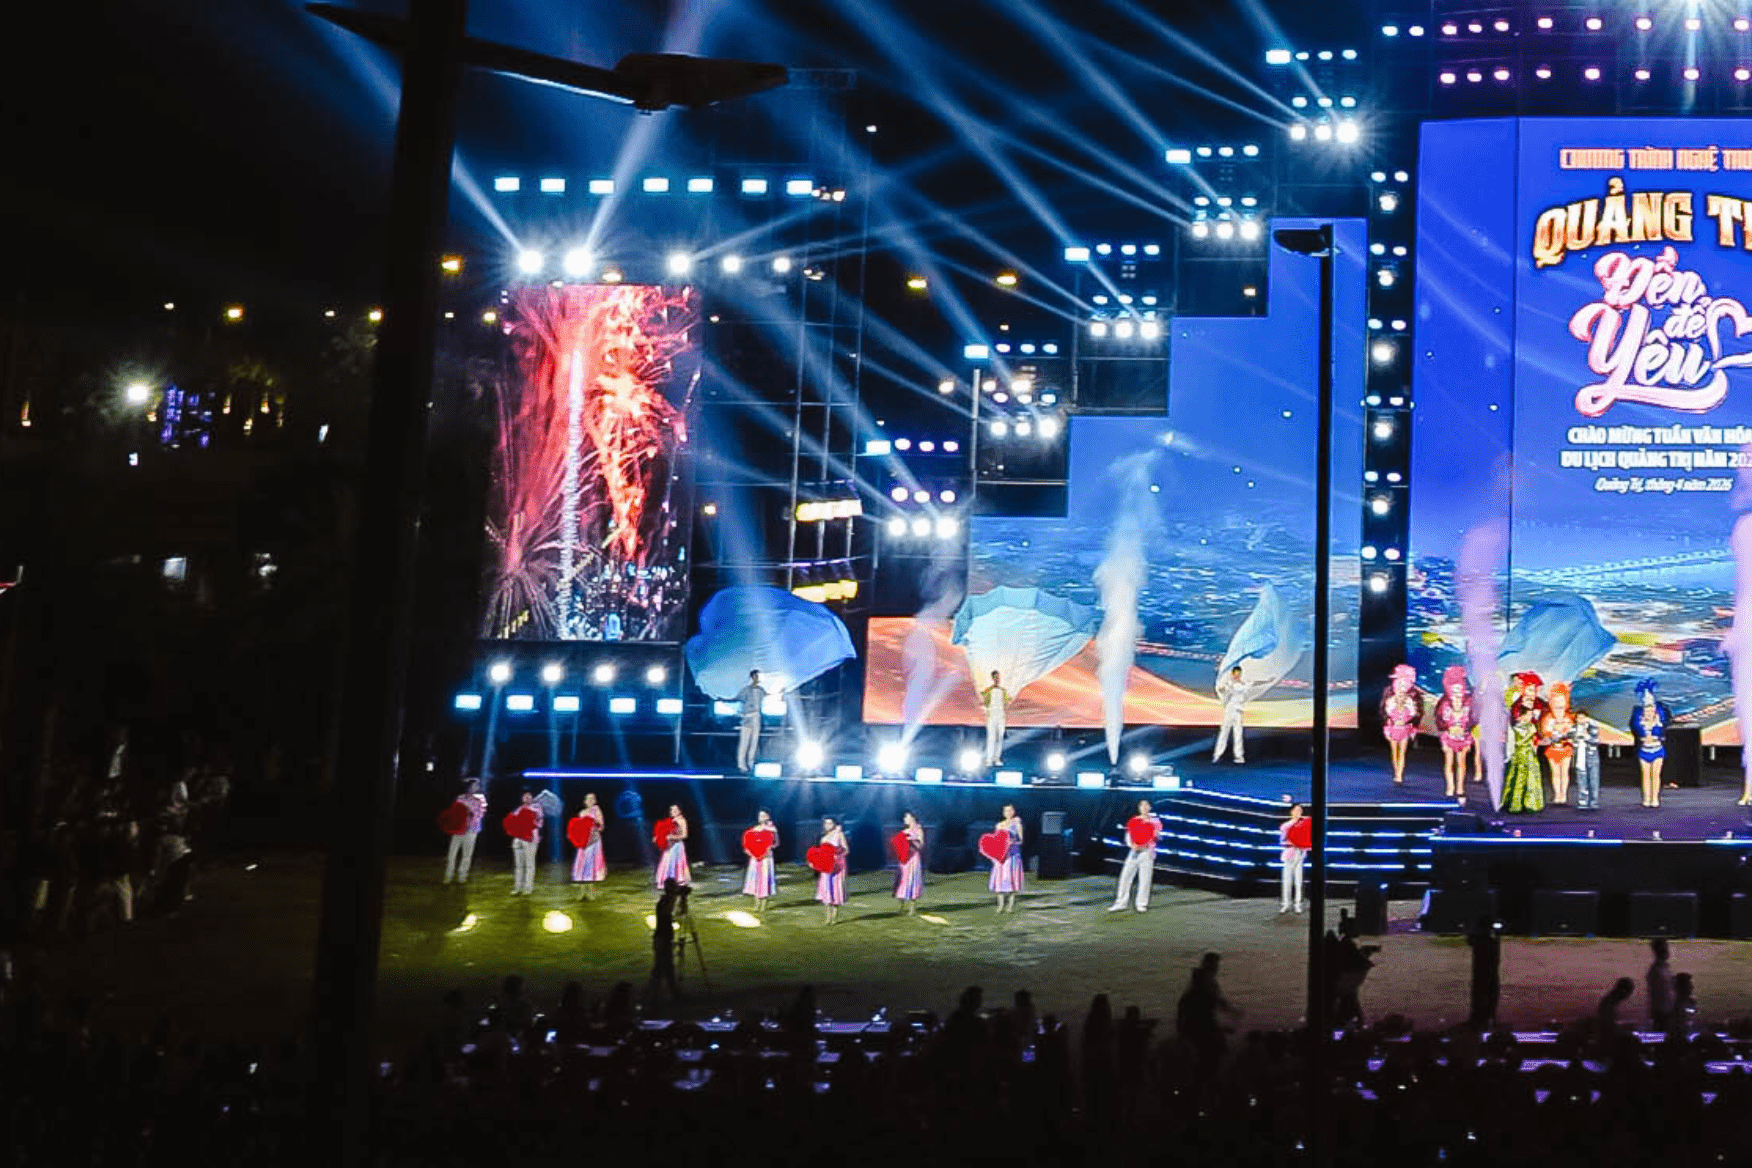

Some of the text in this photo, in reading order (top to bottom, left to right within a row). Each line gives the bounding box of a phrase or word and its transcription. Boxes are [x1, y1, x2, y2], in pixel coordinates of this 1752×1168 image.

[1532, 176, 1693, 269] QUẢNG
[1568, 301, 1728, 419] Yêu
[1560, 450, 1583, 468] DU
[1584, 450, 1617, 471] LỊCH
[1617, 447, 1668, 469] QUẢNG
